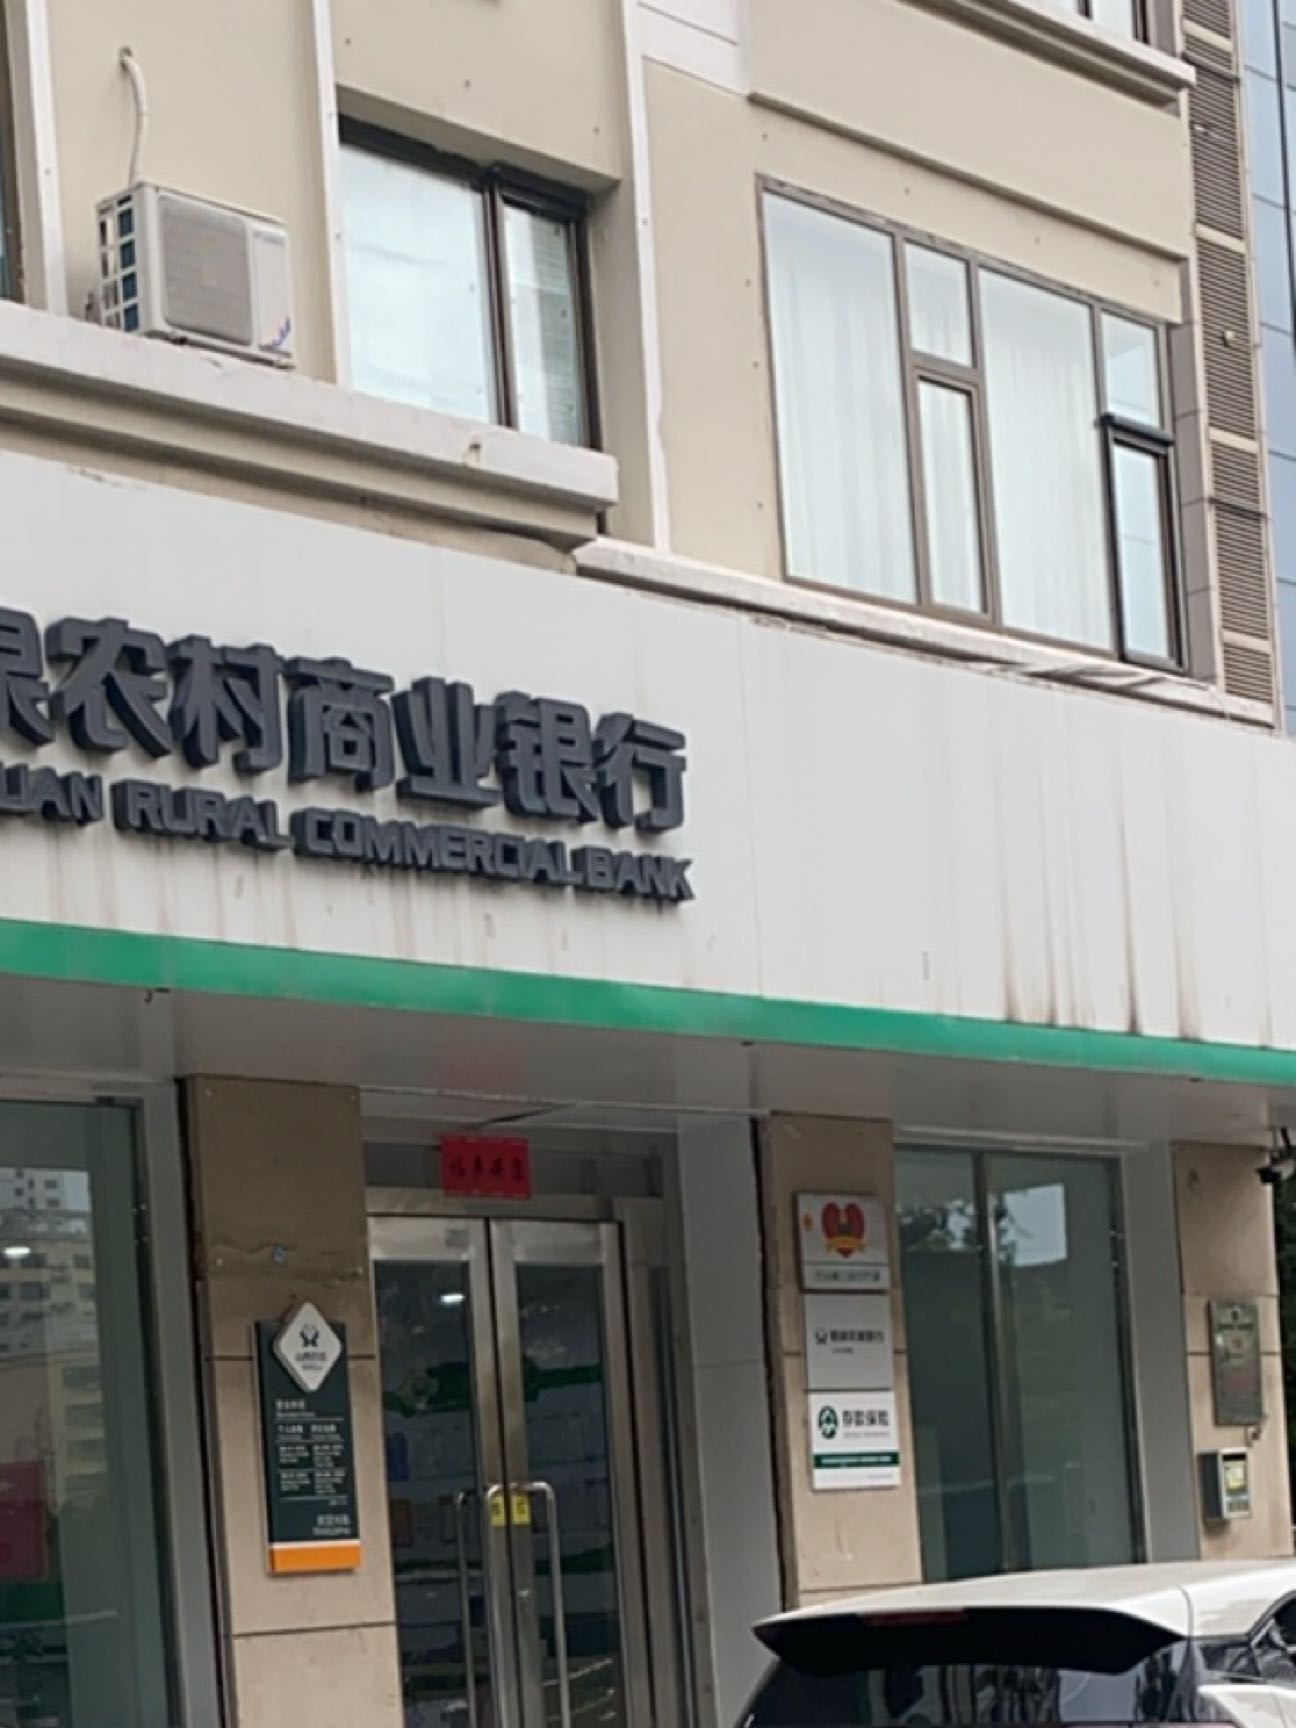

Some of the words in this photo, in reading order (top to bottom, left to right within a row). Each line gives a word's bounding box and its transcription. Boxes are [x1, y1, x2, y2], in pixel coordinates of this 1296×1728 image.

[110, 778, 296, 853] RURAL
[292, 806, 580, 887] COMMERCIAL
[572, 843, 695, 904] BANK
